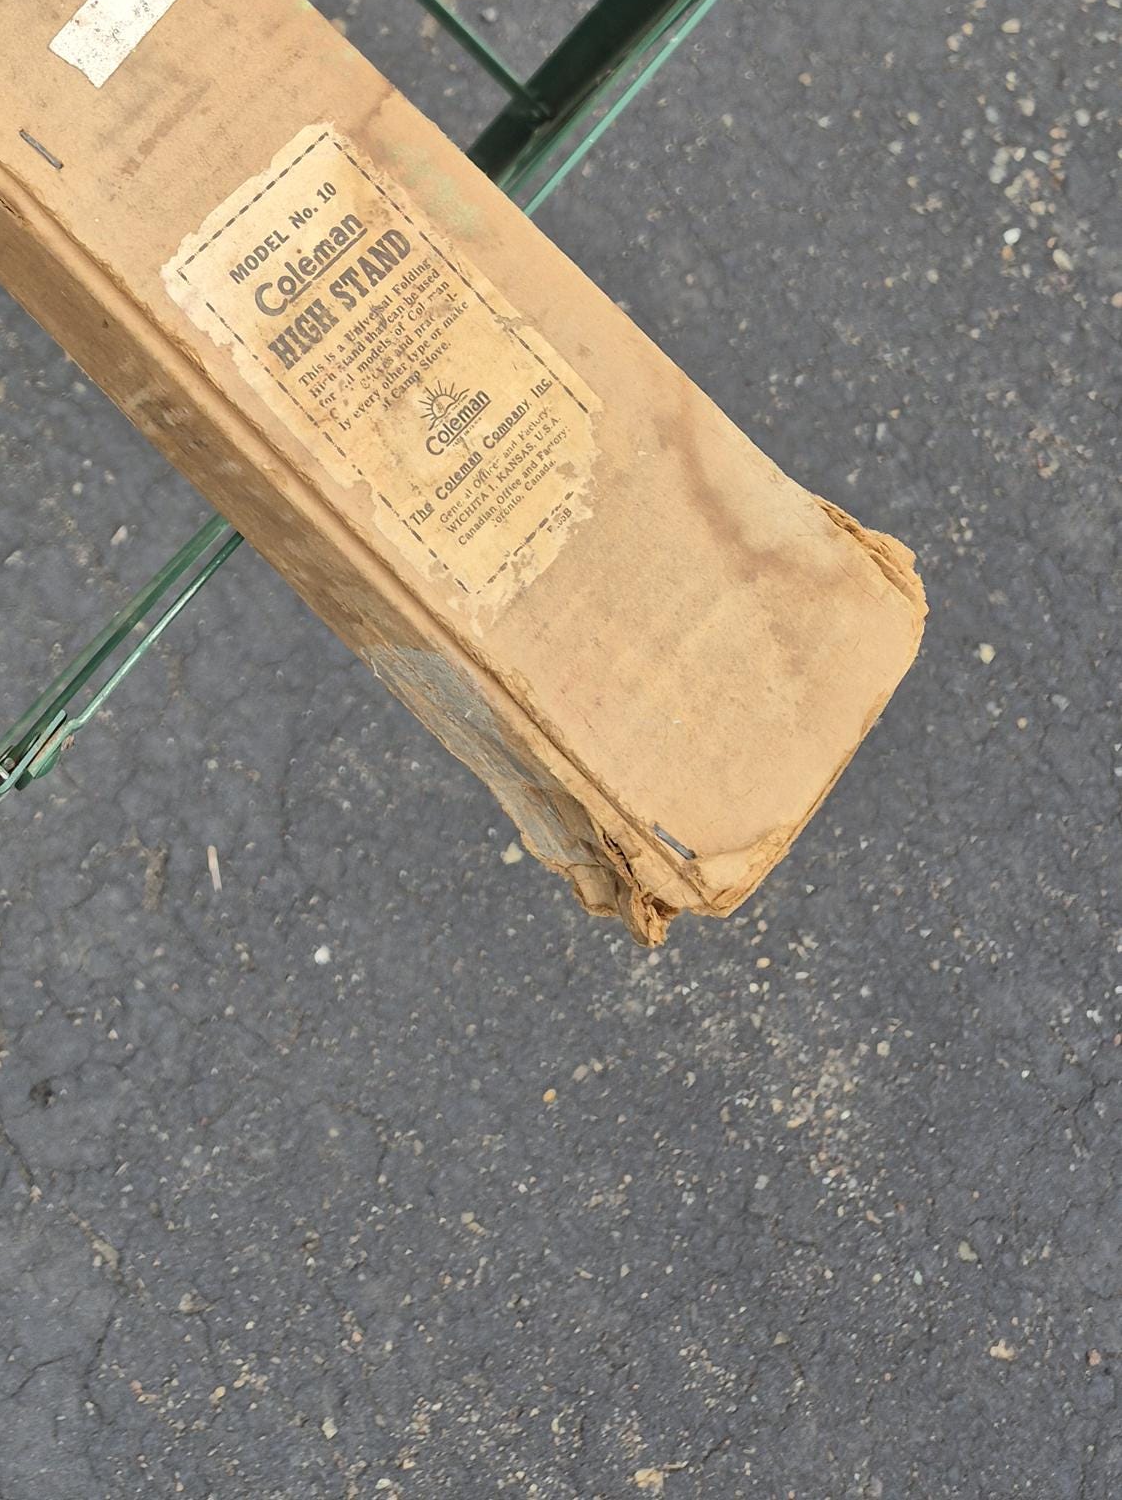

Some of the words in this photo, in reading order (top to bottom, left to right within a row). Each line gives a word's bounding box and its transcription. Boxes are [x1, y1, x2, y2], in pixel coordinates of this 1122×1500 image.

[228, 228, 290, 284] MODEL
[288, 203, 318, 229] No.
[316, 181, 337, 204] 10
[251, 212, 367, 319] Coleman
[267, 298, 339, 370] HIGH
[328, 227, 414, 312] STAND
[298, 362, 325, 387] This
[324, 351, 335, 364] is
[336, 344, 345, 352] a
[344, 294, 393, 343] Universal
[392, 258, 431, 296] Folding
[386, 304, 405, 323] can
[402, 291, 419, 305] be
[416, 268, 440, 293] used
[338, 417, 352, 431] ly
[352, 389, 381, 418] every
[380, 361, 408, 390] other
[406, 339, 431, 363] type
[430, 328, 442, 340] or
[442, 300, 468, 328] make
[356, 336, 392, 373] models
[393, 321, 406, 336] of
[390, 369, 422, 399] Camp
[419, 340, 451, 370] Stove.
[393, 334, 414, 357] and
[424, 390, 491, 457] Coleman
[502, 439, 517, 458] and
[409, 501, 435, 526] The
[434, 450, 483, 501] Coleman
[446, 491, 489, 534] WICHITA
[534, 416, 561, 441] U.S.A.
[458, 506, 497, 545] Canadian
[495, 478, 521, 505] Office
[521, 459, 538, 478] and
